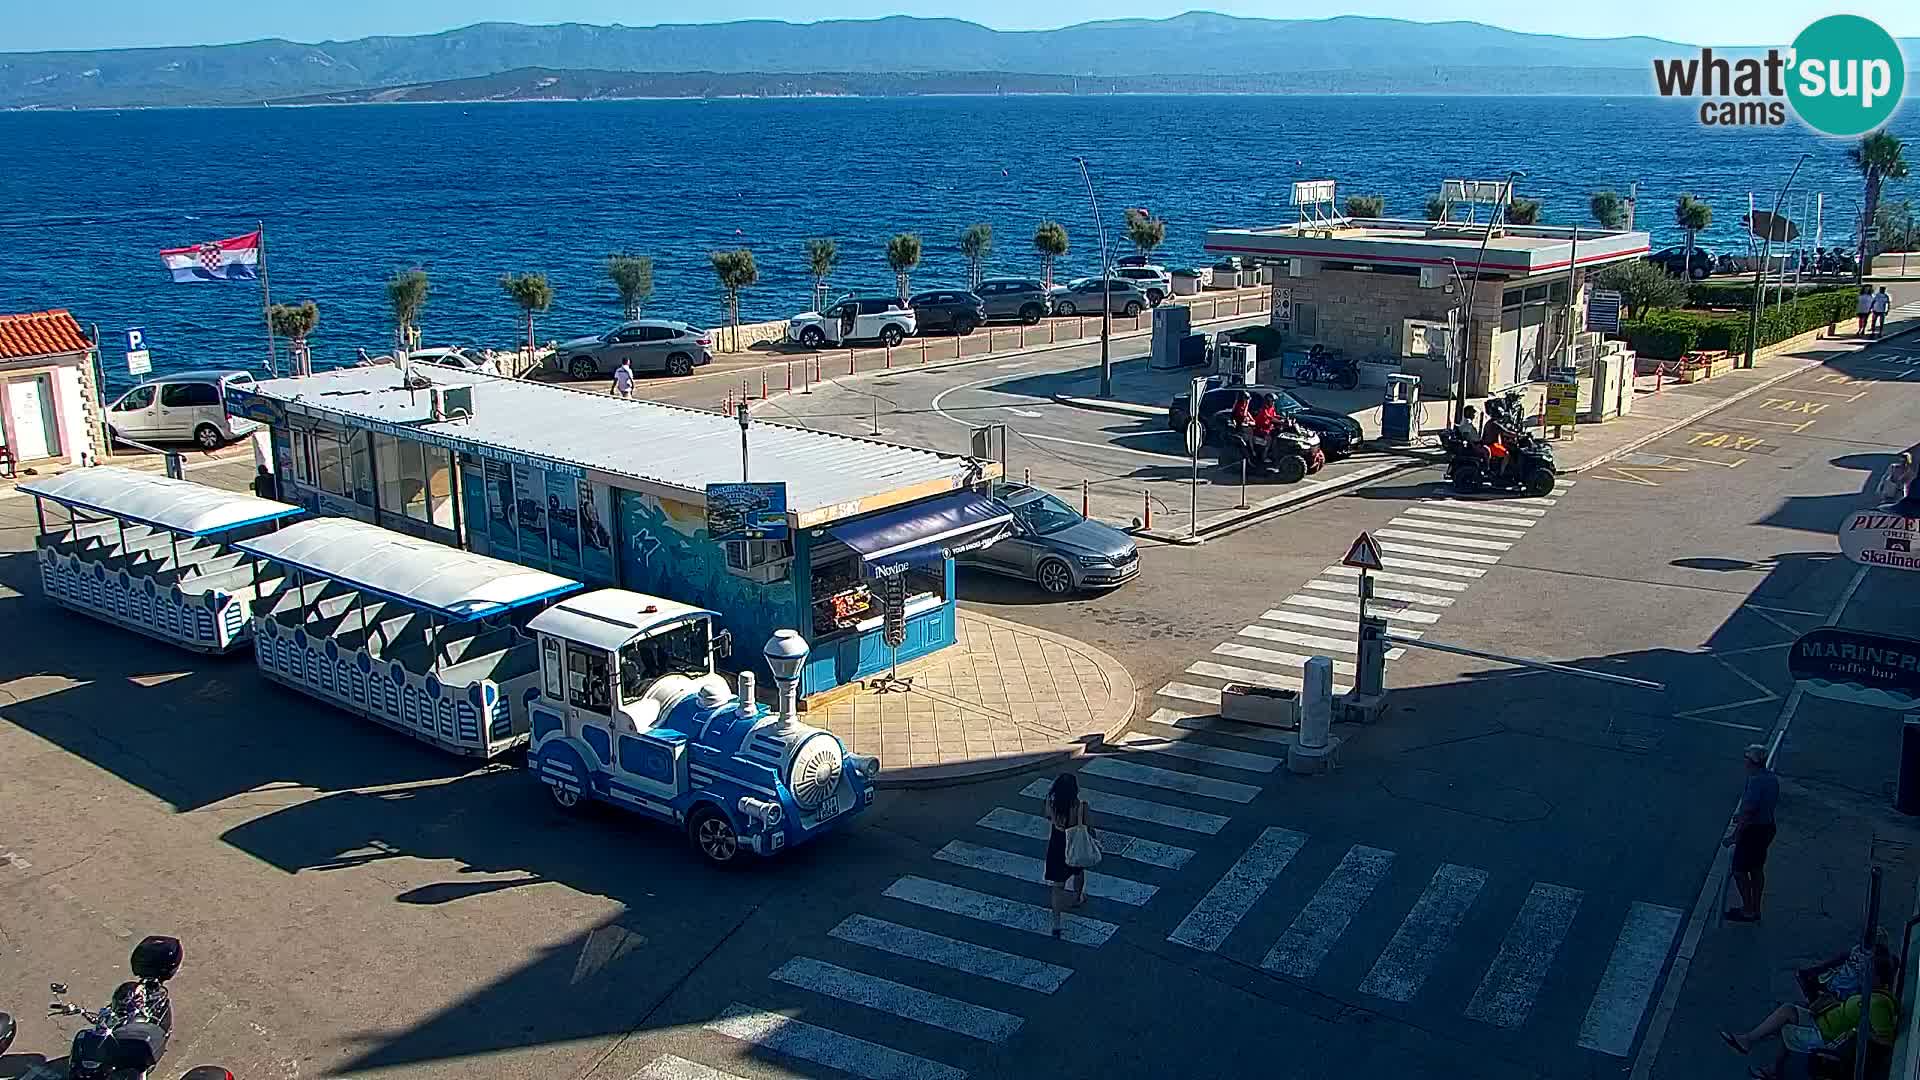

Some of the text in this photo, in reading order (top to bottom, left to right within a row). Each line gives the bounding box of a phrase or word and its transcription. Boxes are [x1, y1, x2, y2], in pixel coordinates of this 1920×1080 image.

[129, 331, 142, 350] P
[1759, 398, 1831, 415] TAXI
[1687, 431, 1765, 451] TAXI
[478, 446, 492, 458] BUS
[495, 450, 526, 465] STATION
[529, 457, 554, 472] TICKET
[555, 463, 582, 477] OFFICE
[1849, 514, 1920, 533] PIZZE
